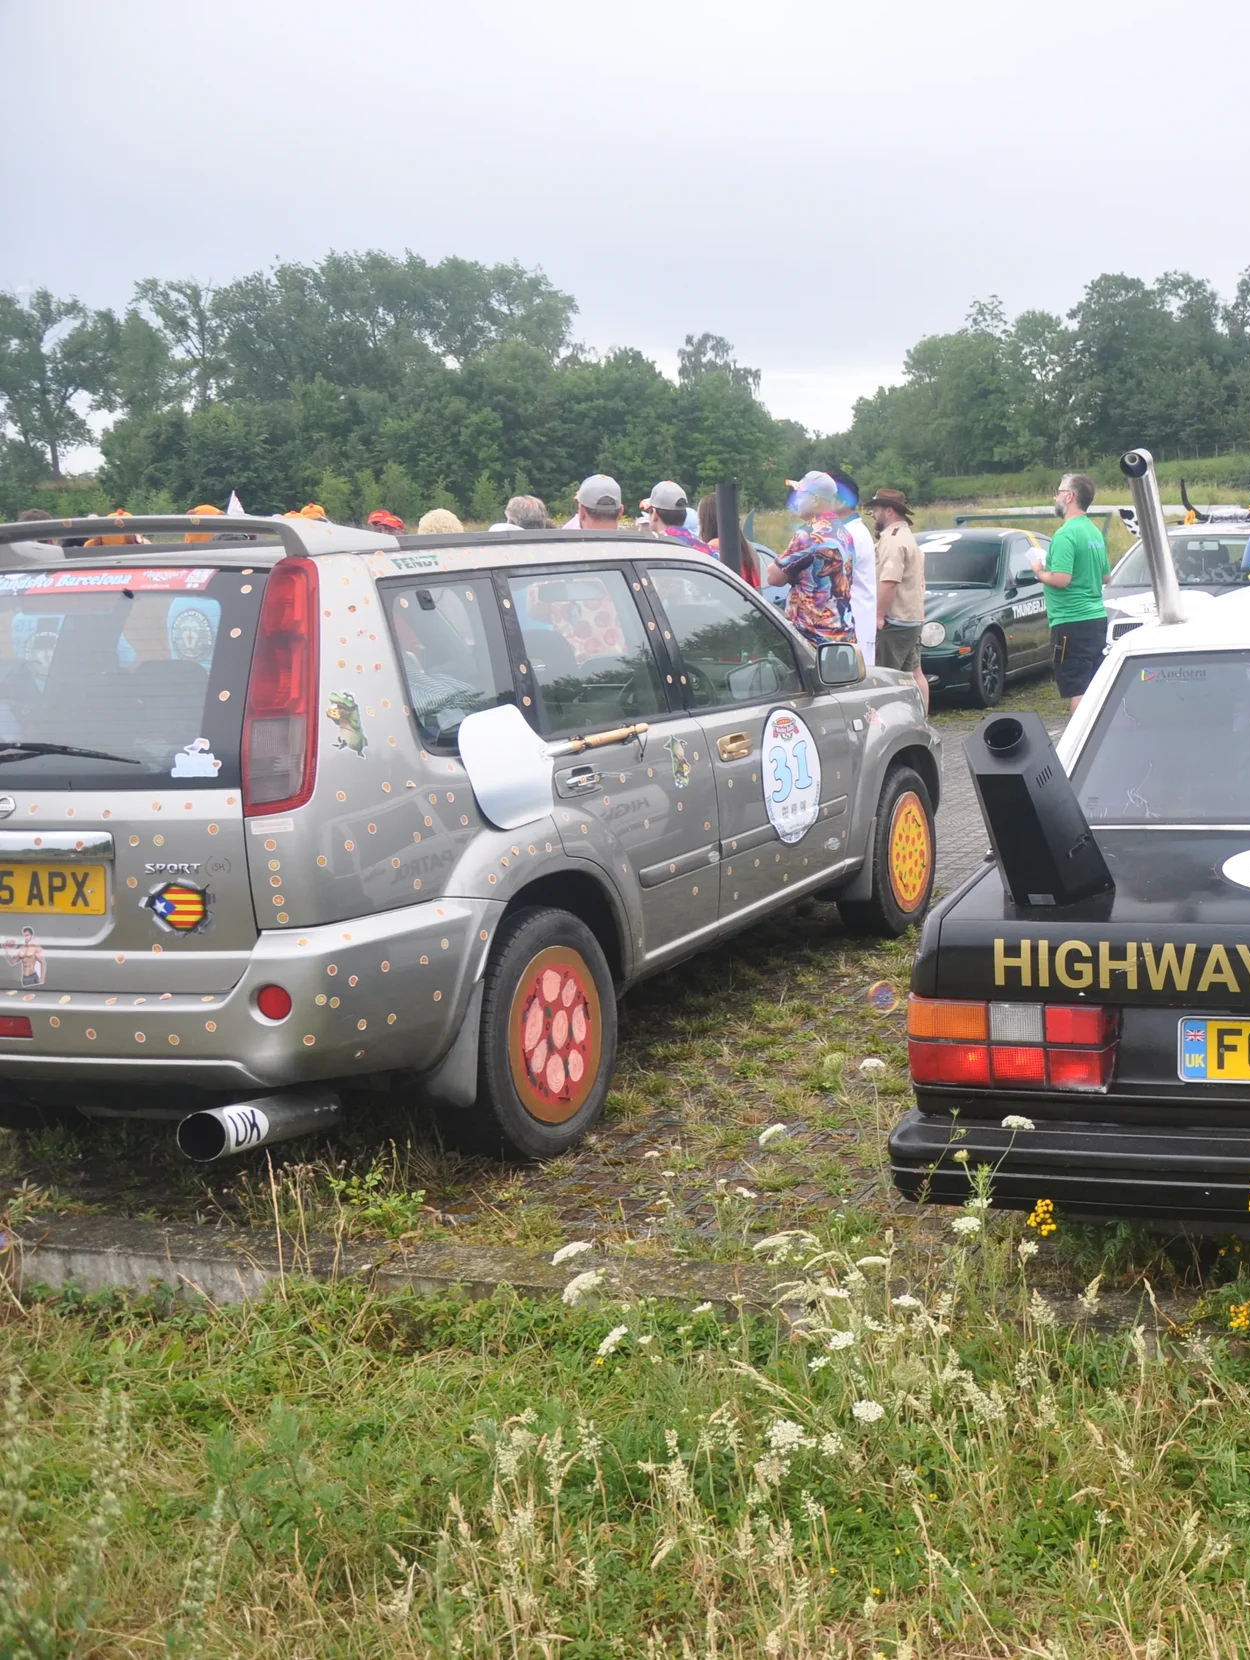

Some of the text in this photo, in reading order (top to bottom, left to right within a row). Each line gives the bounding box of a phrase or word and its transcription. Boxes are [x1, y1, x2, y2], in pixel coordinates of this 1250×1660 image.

[390, 554, 439, 571] FENDT
[55, 573, 132, 588] Barcelona
[1158, 668, 1206, 679] Andorra
[768, 740, 813, 803] 31
[144, 863, 201, 875] SPORT
[26, 870, 90, 907] APX
[1184, 1053, 1206, 1069] UK
[227, 1109, 261, 1148] UK
